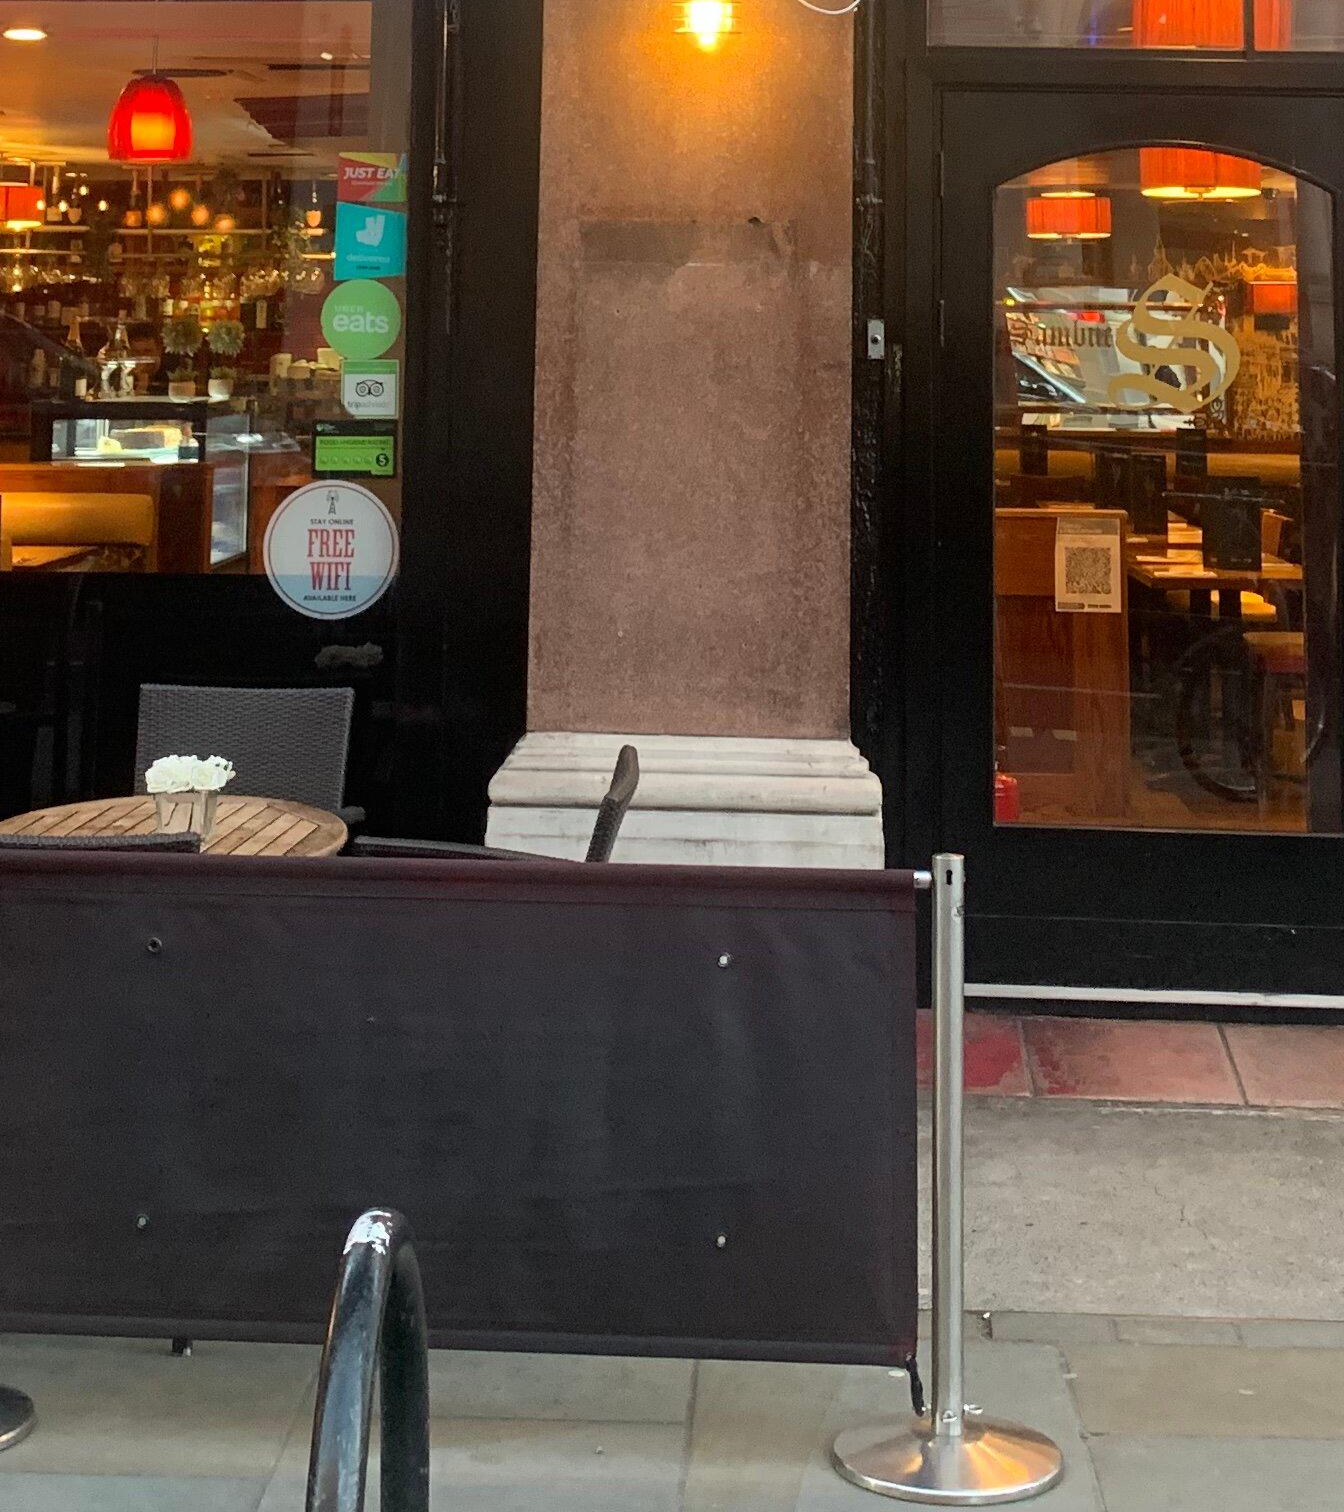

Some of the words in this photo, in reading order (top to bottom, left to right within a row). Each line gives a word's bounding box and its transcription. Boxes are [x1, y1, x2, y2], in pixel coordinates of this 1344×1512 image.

[344, 166, 375, 180] JUST
[332, 311, 389, 334] eats
[1107, 272, 1241, 413] S
[307, 528, 356, 558] FREE
[309, 561, 353, 591] WIFI
